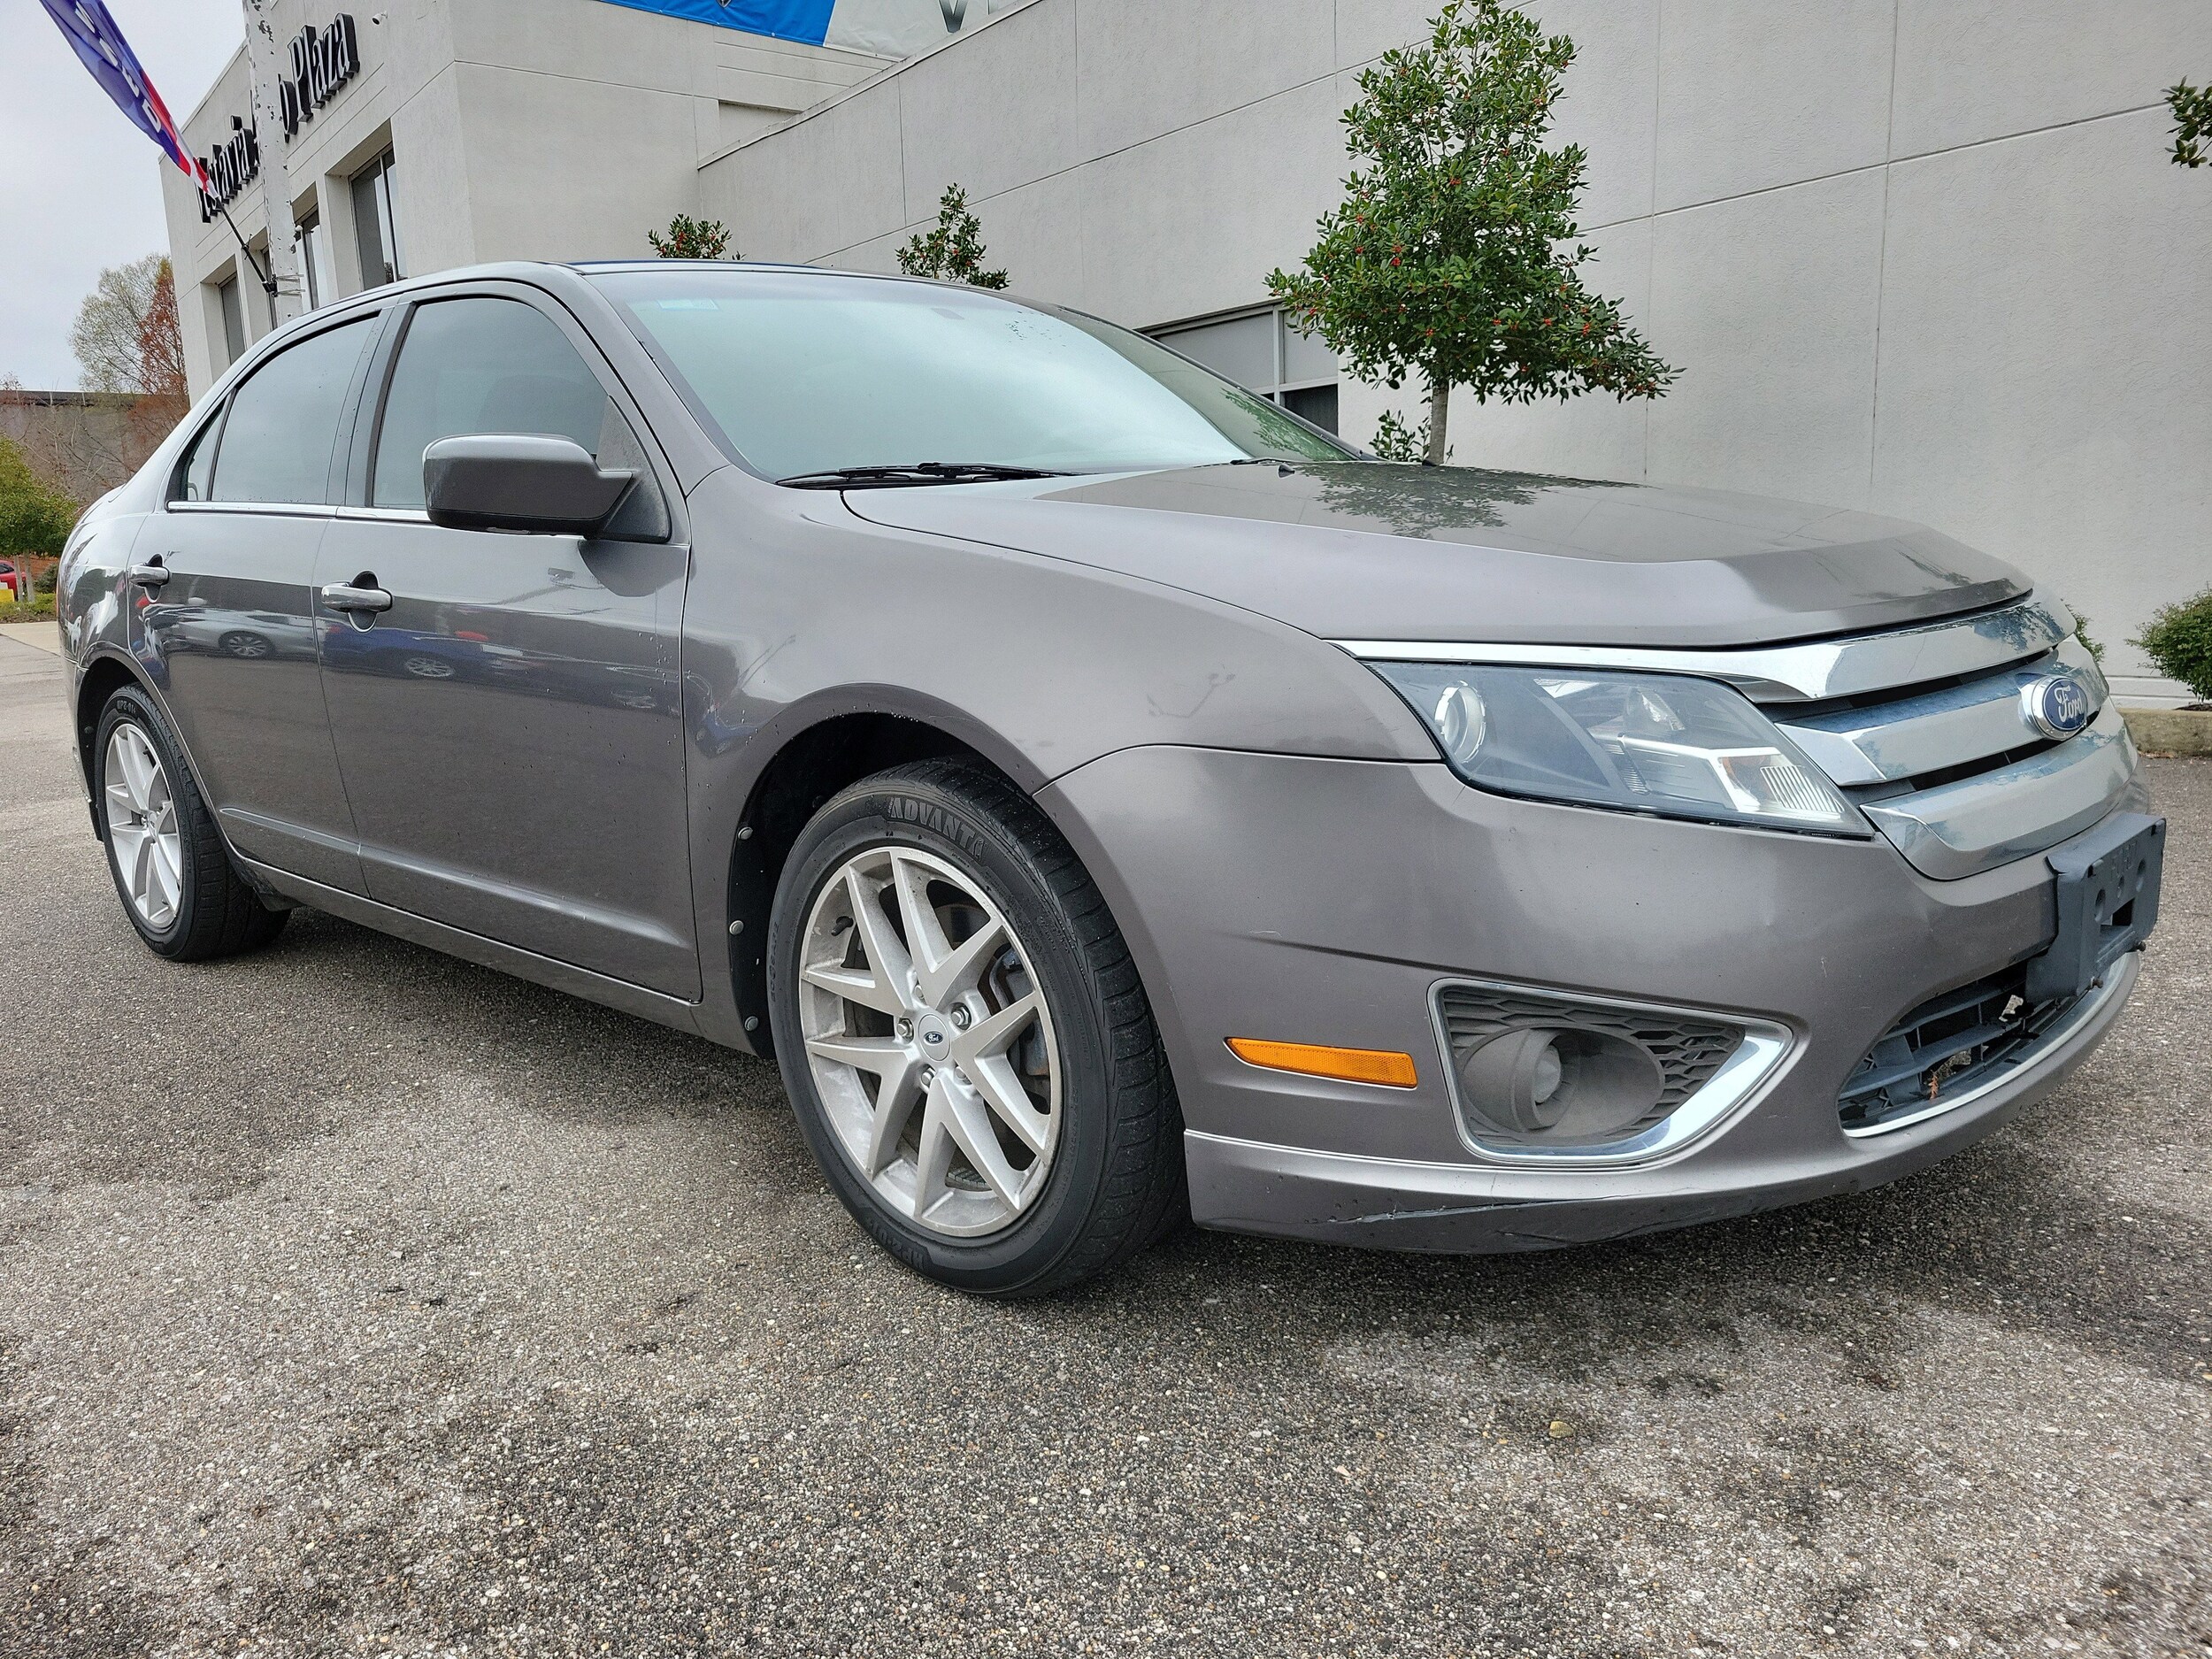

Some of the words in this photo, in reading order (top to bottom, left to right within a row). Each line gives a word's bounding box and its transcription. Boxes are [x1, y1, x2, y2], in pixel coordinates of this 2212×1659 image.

[288, 12, 360, 122] Plaza
[2054, 685, 2084, 723] Ford
[889, 796, 984, 862] ADVANTA
